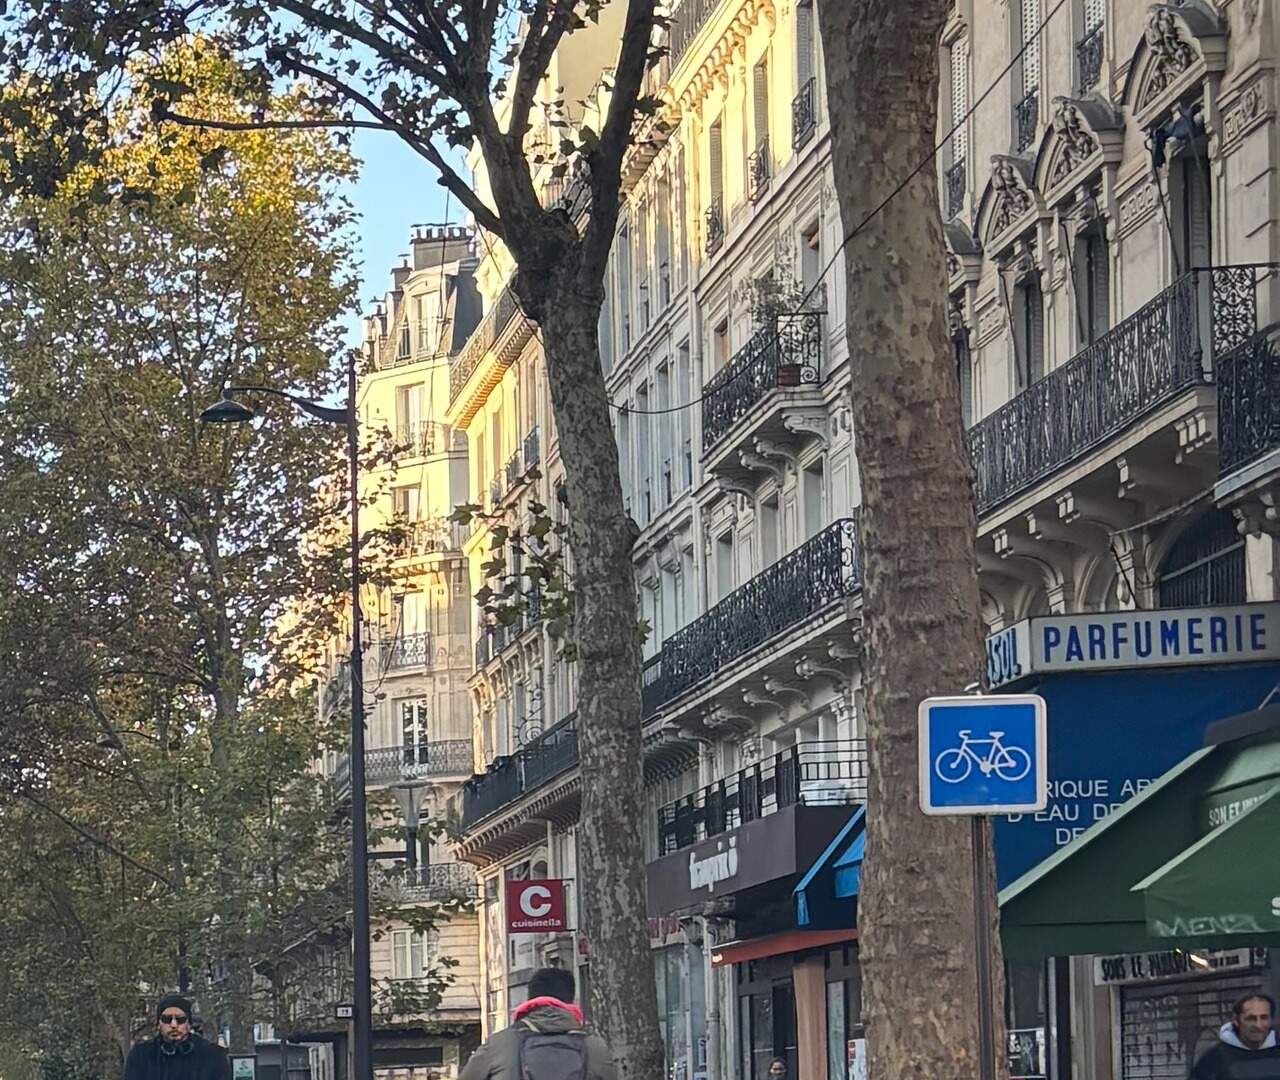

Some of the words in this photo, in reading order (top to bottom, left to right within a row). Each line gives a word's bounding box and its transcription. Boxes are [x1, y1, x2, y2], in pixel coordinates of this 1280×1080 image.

[1044, 614, 1266, 662] PARFUMERIE
[1046, 780, 1108, 798] RIQUE
[520, 885, 552, 917] C
[511, 918, 561, 928] cuisinella
